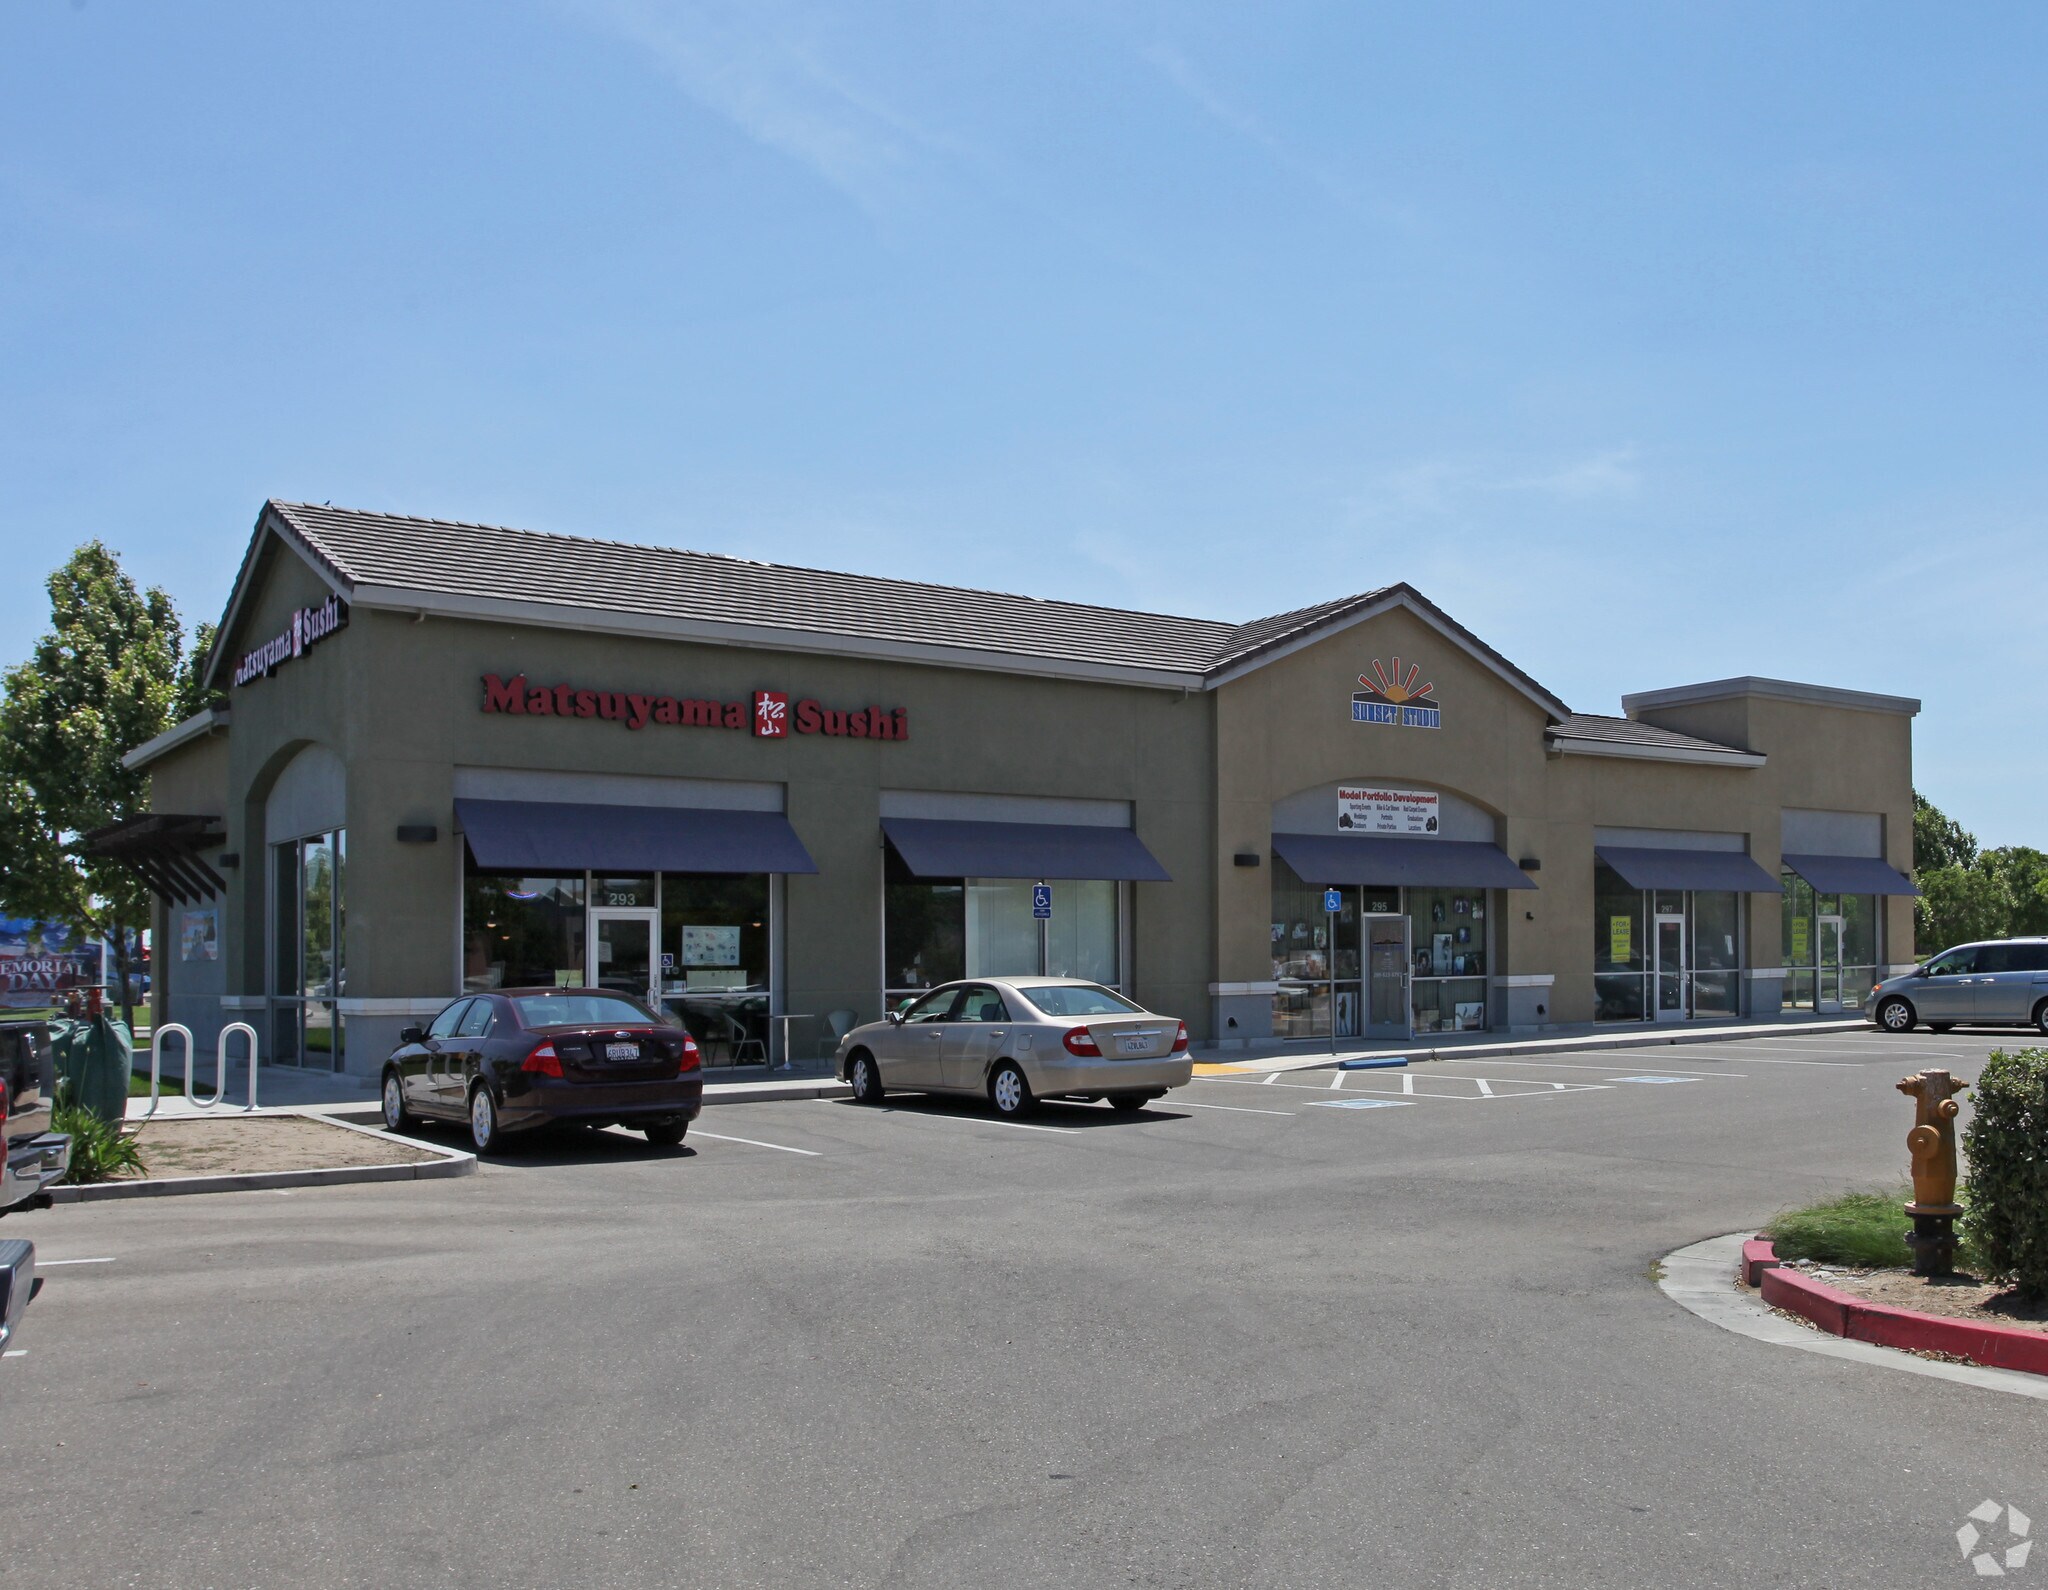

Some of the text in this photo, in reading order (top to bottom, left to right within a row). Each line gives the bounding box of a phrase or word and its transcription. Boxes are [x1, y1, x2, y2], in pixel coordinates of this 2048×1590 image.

[234, 629, 293, 687] Matsuyama
[303, 590, 339, 646] Sushi
[481, 672, 748, 731] Matsuyama
[758, 693, 786, 736] 松山
[794, 699, 909, 741] Sushi
[1351, 701, 1441, 729] SUNSET STUDIO
[1339, 790, 1437, 805] Model Portfolio Development
[609, 893, 636, 906] 293
[1372, 901, 1387, 912] 295
[1661, 905, 1673, 913] 297
[0, 960, 87, 977] EMORIAL
[8, 973, 60, 991] DAY
